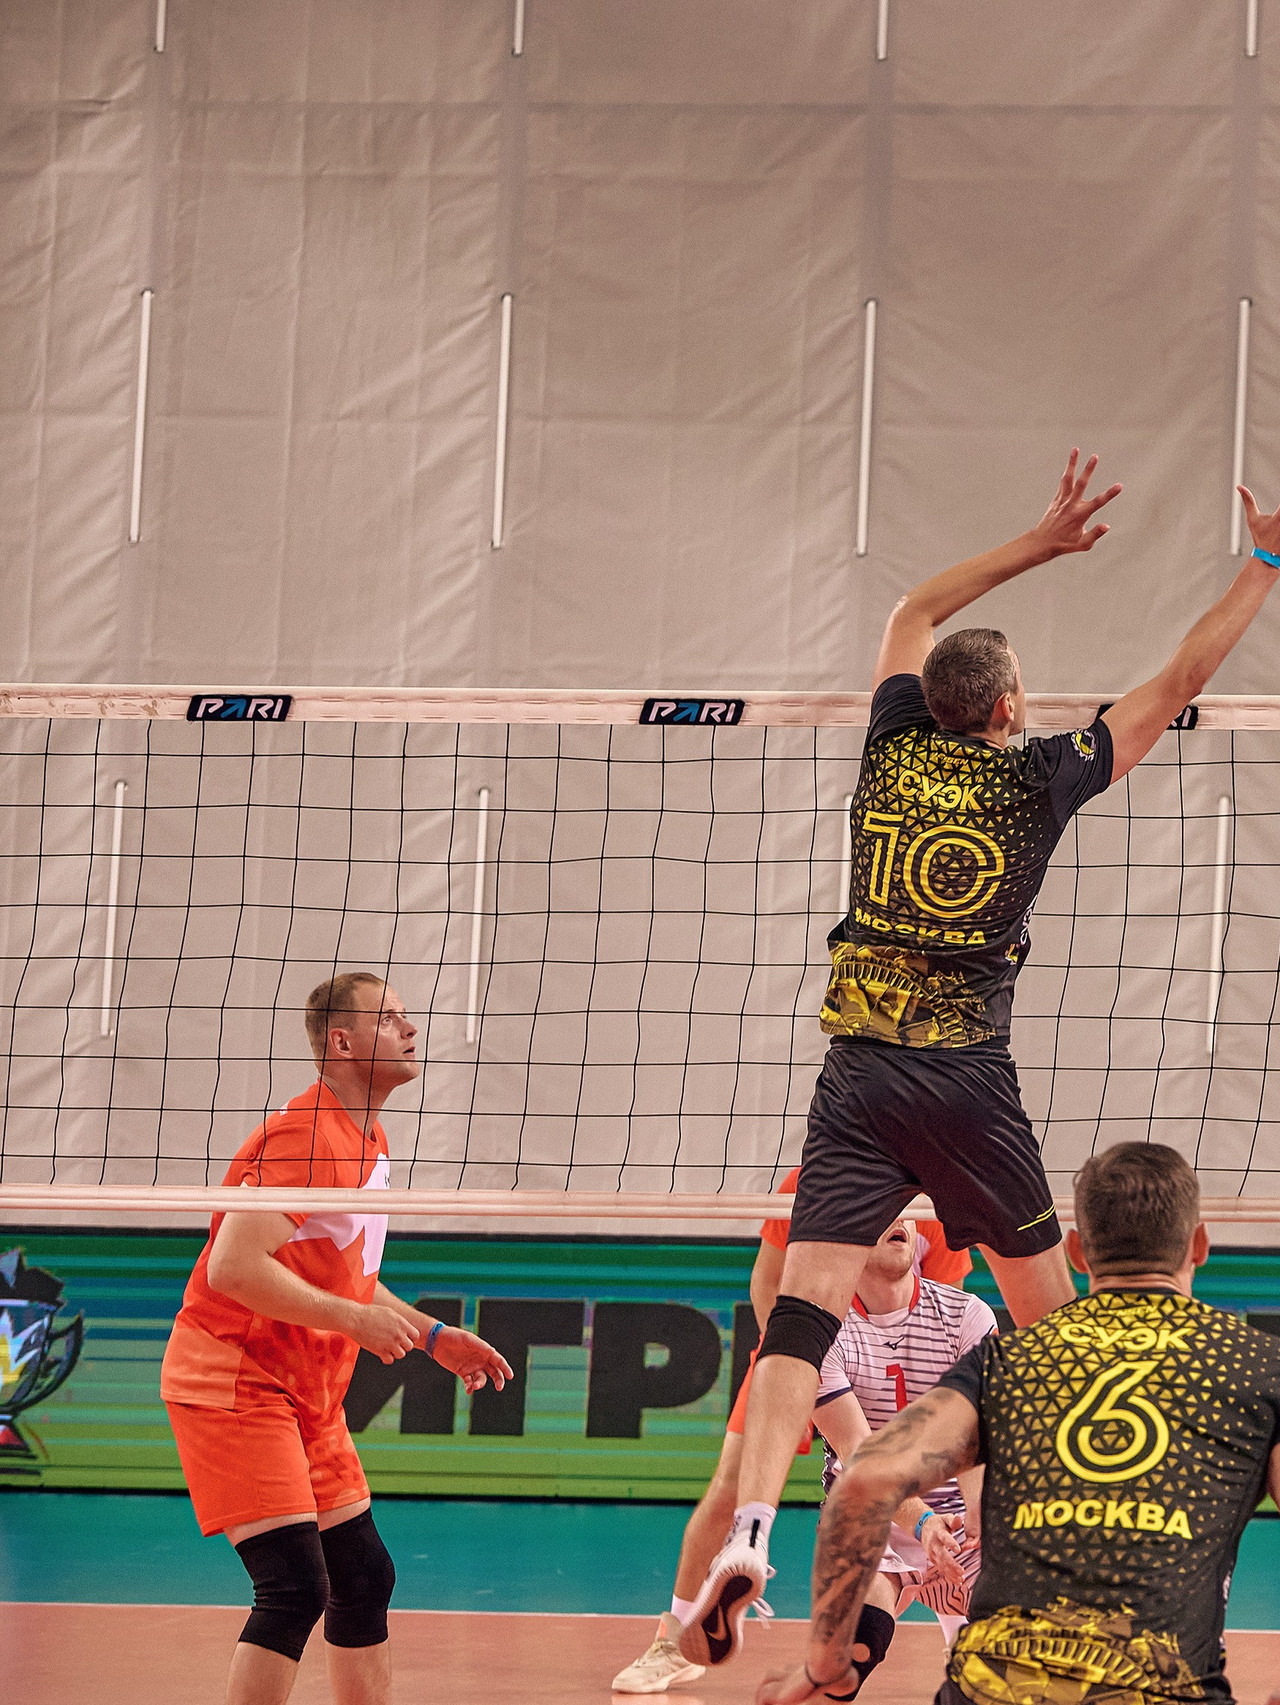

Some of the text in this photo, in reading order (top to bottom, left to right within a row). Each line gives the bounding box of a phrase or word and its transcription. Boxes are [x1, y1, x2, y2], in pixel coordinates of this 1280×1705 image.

[196, 698, 283, 718] PARI
[648, 701, 736, 722] PARI
[898, 769, 983, 811] СУЭК
[862, 810, 1005, 919] 10
[1059, 1323, 1193, 1351] СУЭК
[342, 1297, 765, 1438] ИГР
[886, 1363, 908, 1413] 1
[1056, 1360, 1169, 1484] 6
[1013, 1500, 1193, 1540] МОСКВА
